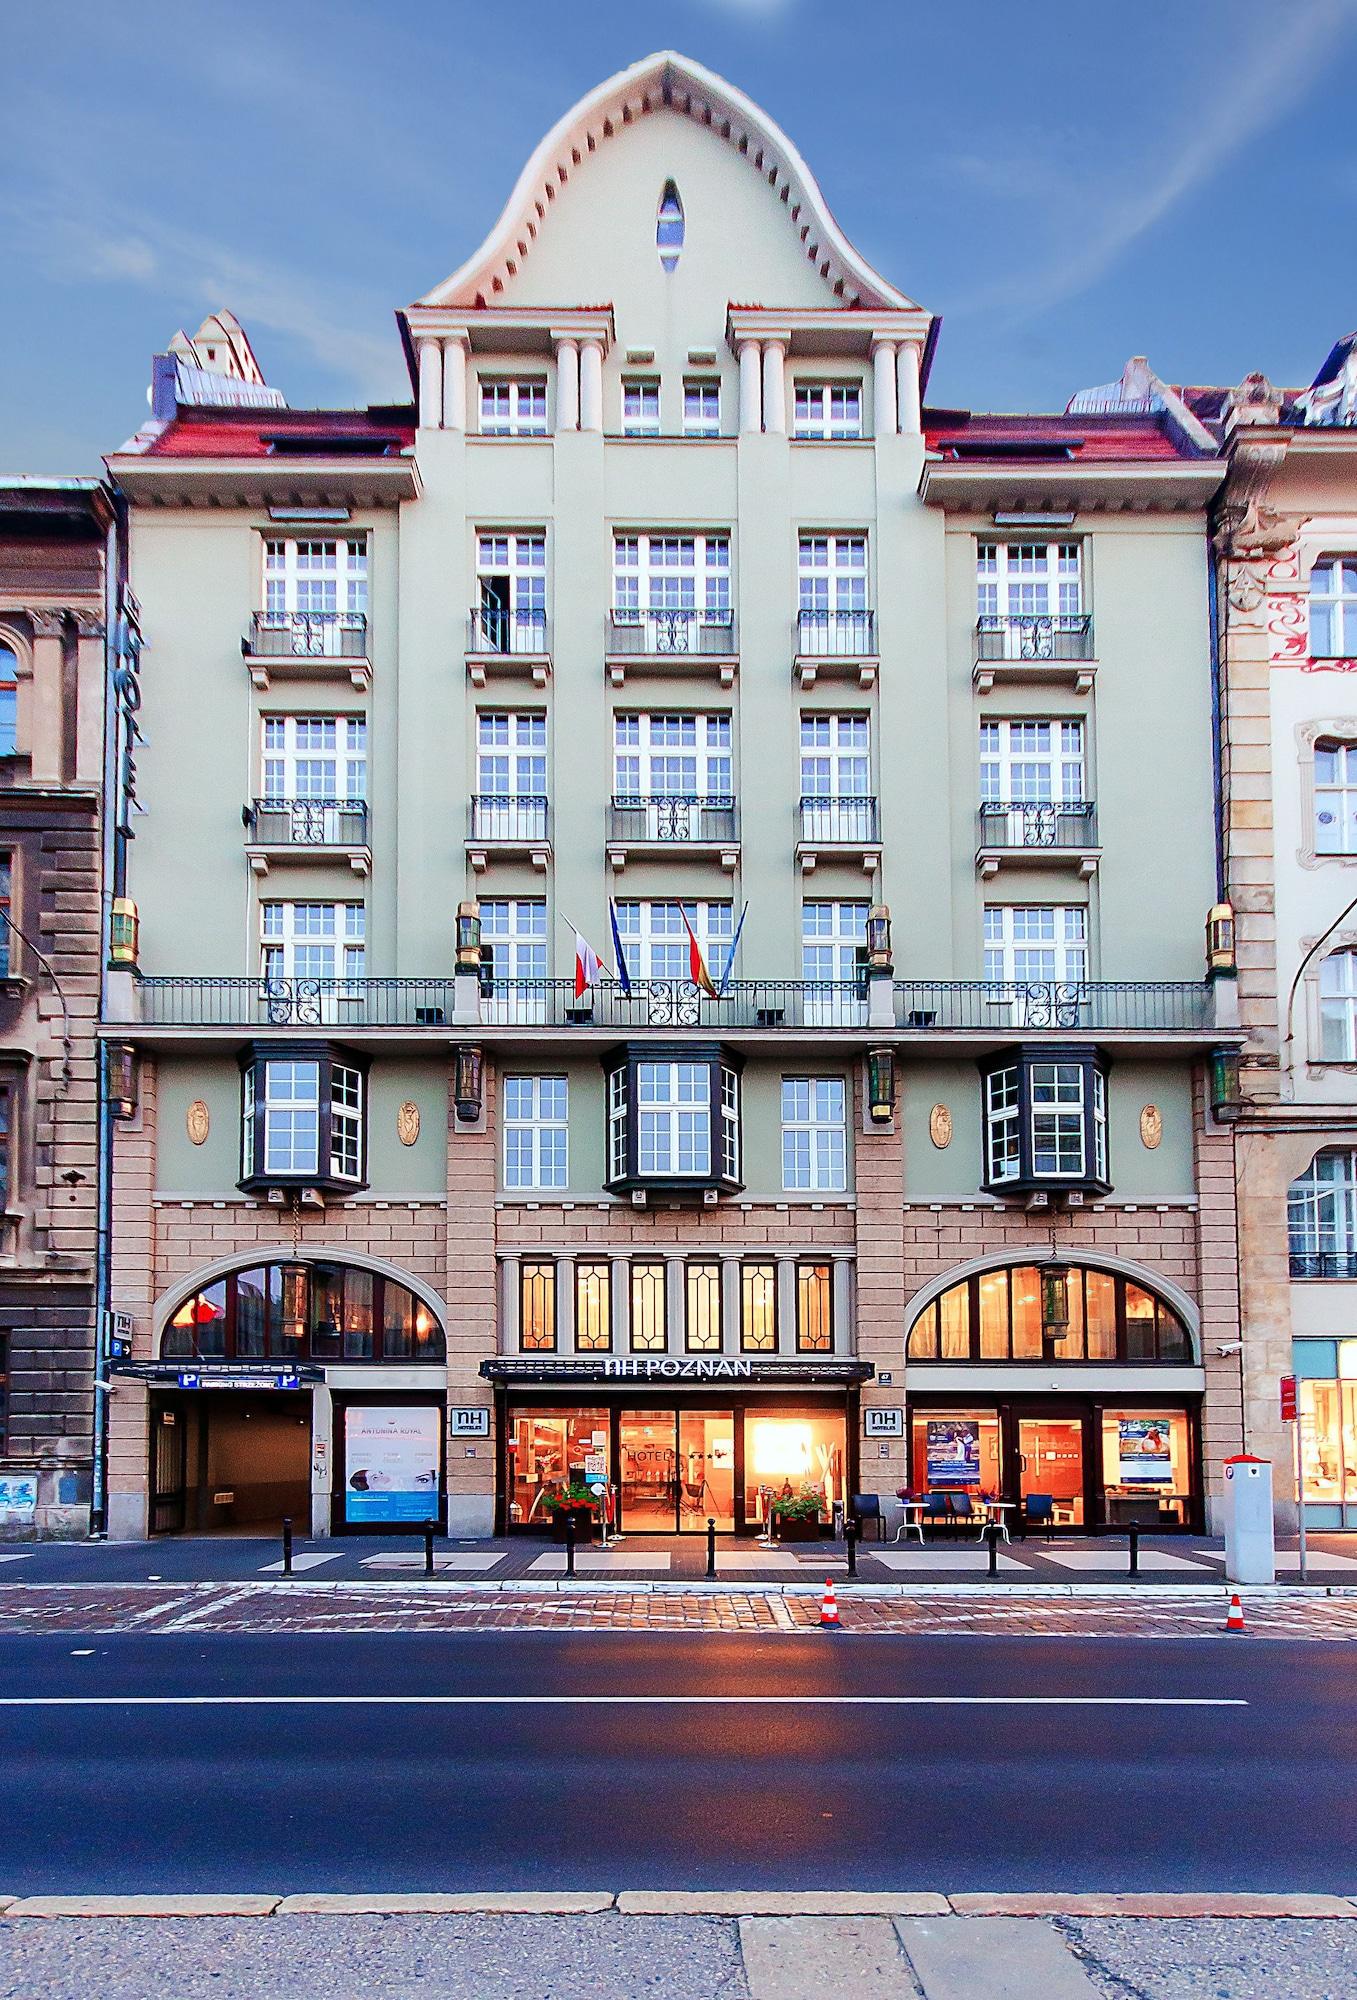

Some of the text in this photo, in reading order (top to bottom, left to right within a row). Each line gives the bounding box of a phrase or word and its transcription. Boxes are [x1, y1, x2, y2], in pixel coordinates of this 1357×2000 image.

[114, 1342, 120, 1354] P
[646, 1359, 751, 1376] POZNAN
[183, 1374, 196, 1386] P
[281, 1374, 295, 1387] P
[627, 1451, 670, 1462] HOTEL
